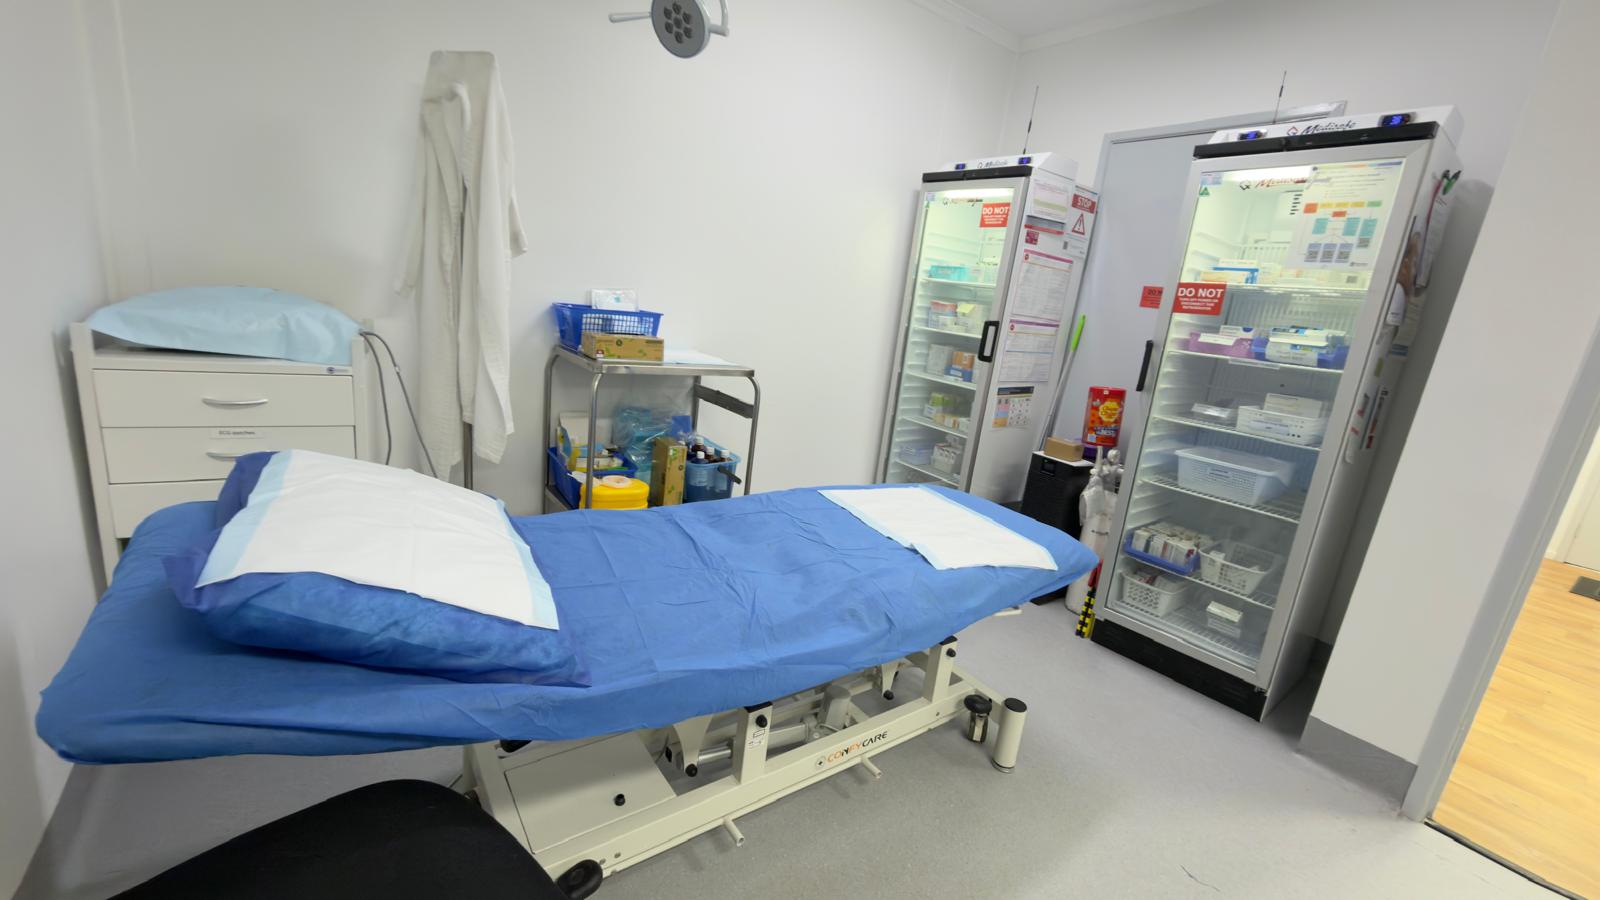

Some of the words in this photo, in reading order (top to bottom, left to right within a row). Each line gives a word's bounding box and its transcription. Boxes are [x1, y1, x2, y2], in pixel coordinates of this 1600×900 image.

[1077, 196, 1092, 208] STOP
[994, 206, 1009, 214] NOT
[1177, 287, 1195, 297] DO
[1198, 288, 1225, 298] NOT
